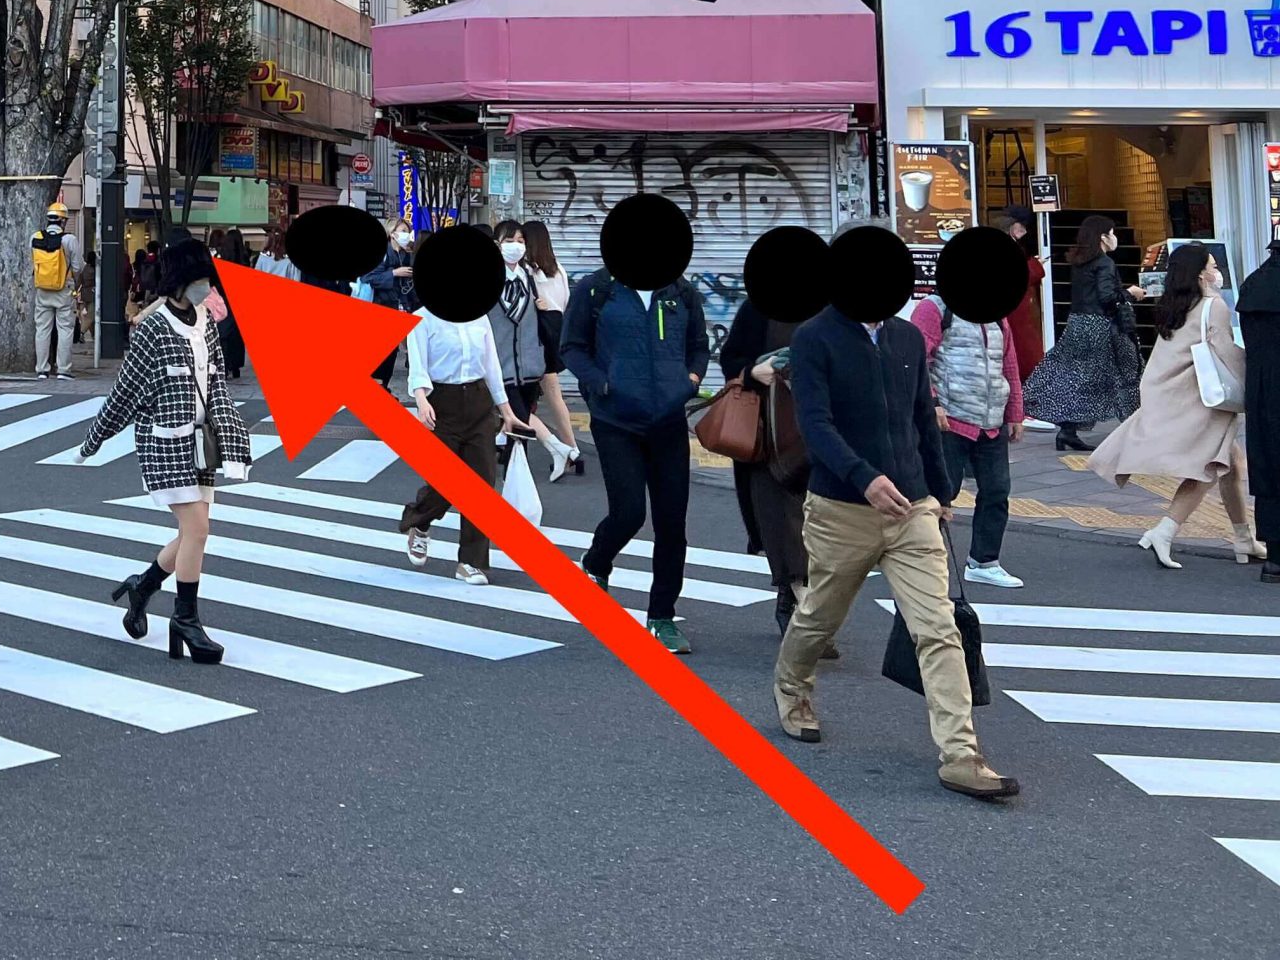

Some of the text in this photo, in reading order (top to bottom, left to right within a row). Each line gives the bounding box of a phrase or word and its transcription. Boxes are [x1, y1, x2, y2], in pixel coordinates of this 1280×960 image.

[944, 9, 1228, 59] 16 TAPI
[896, 146, 938, 154] AUTUMN
[907, 154, 928, 162] FAIR
